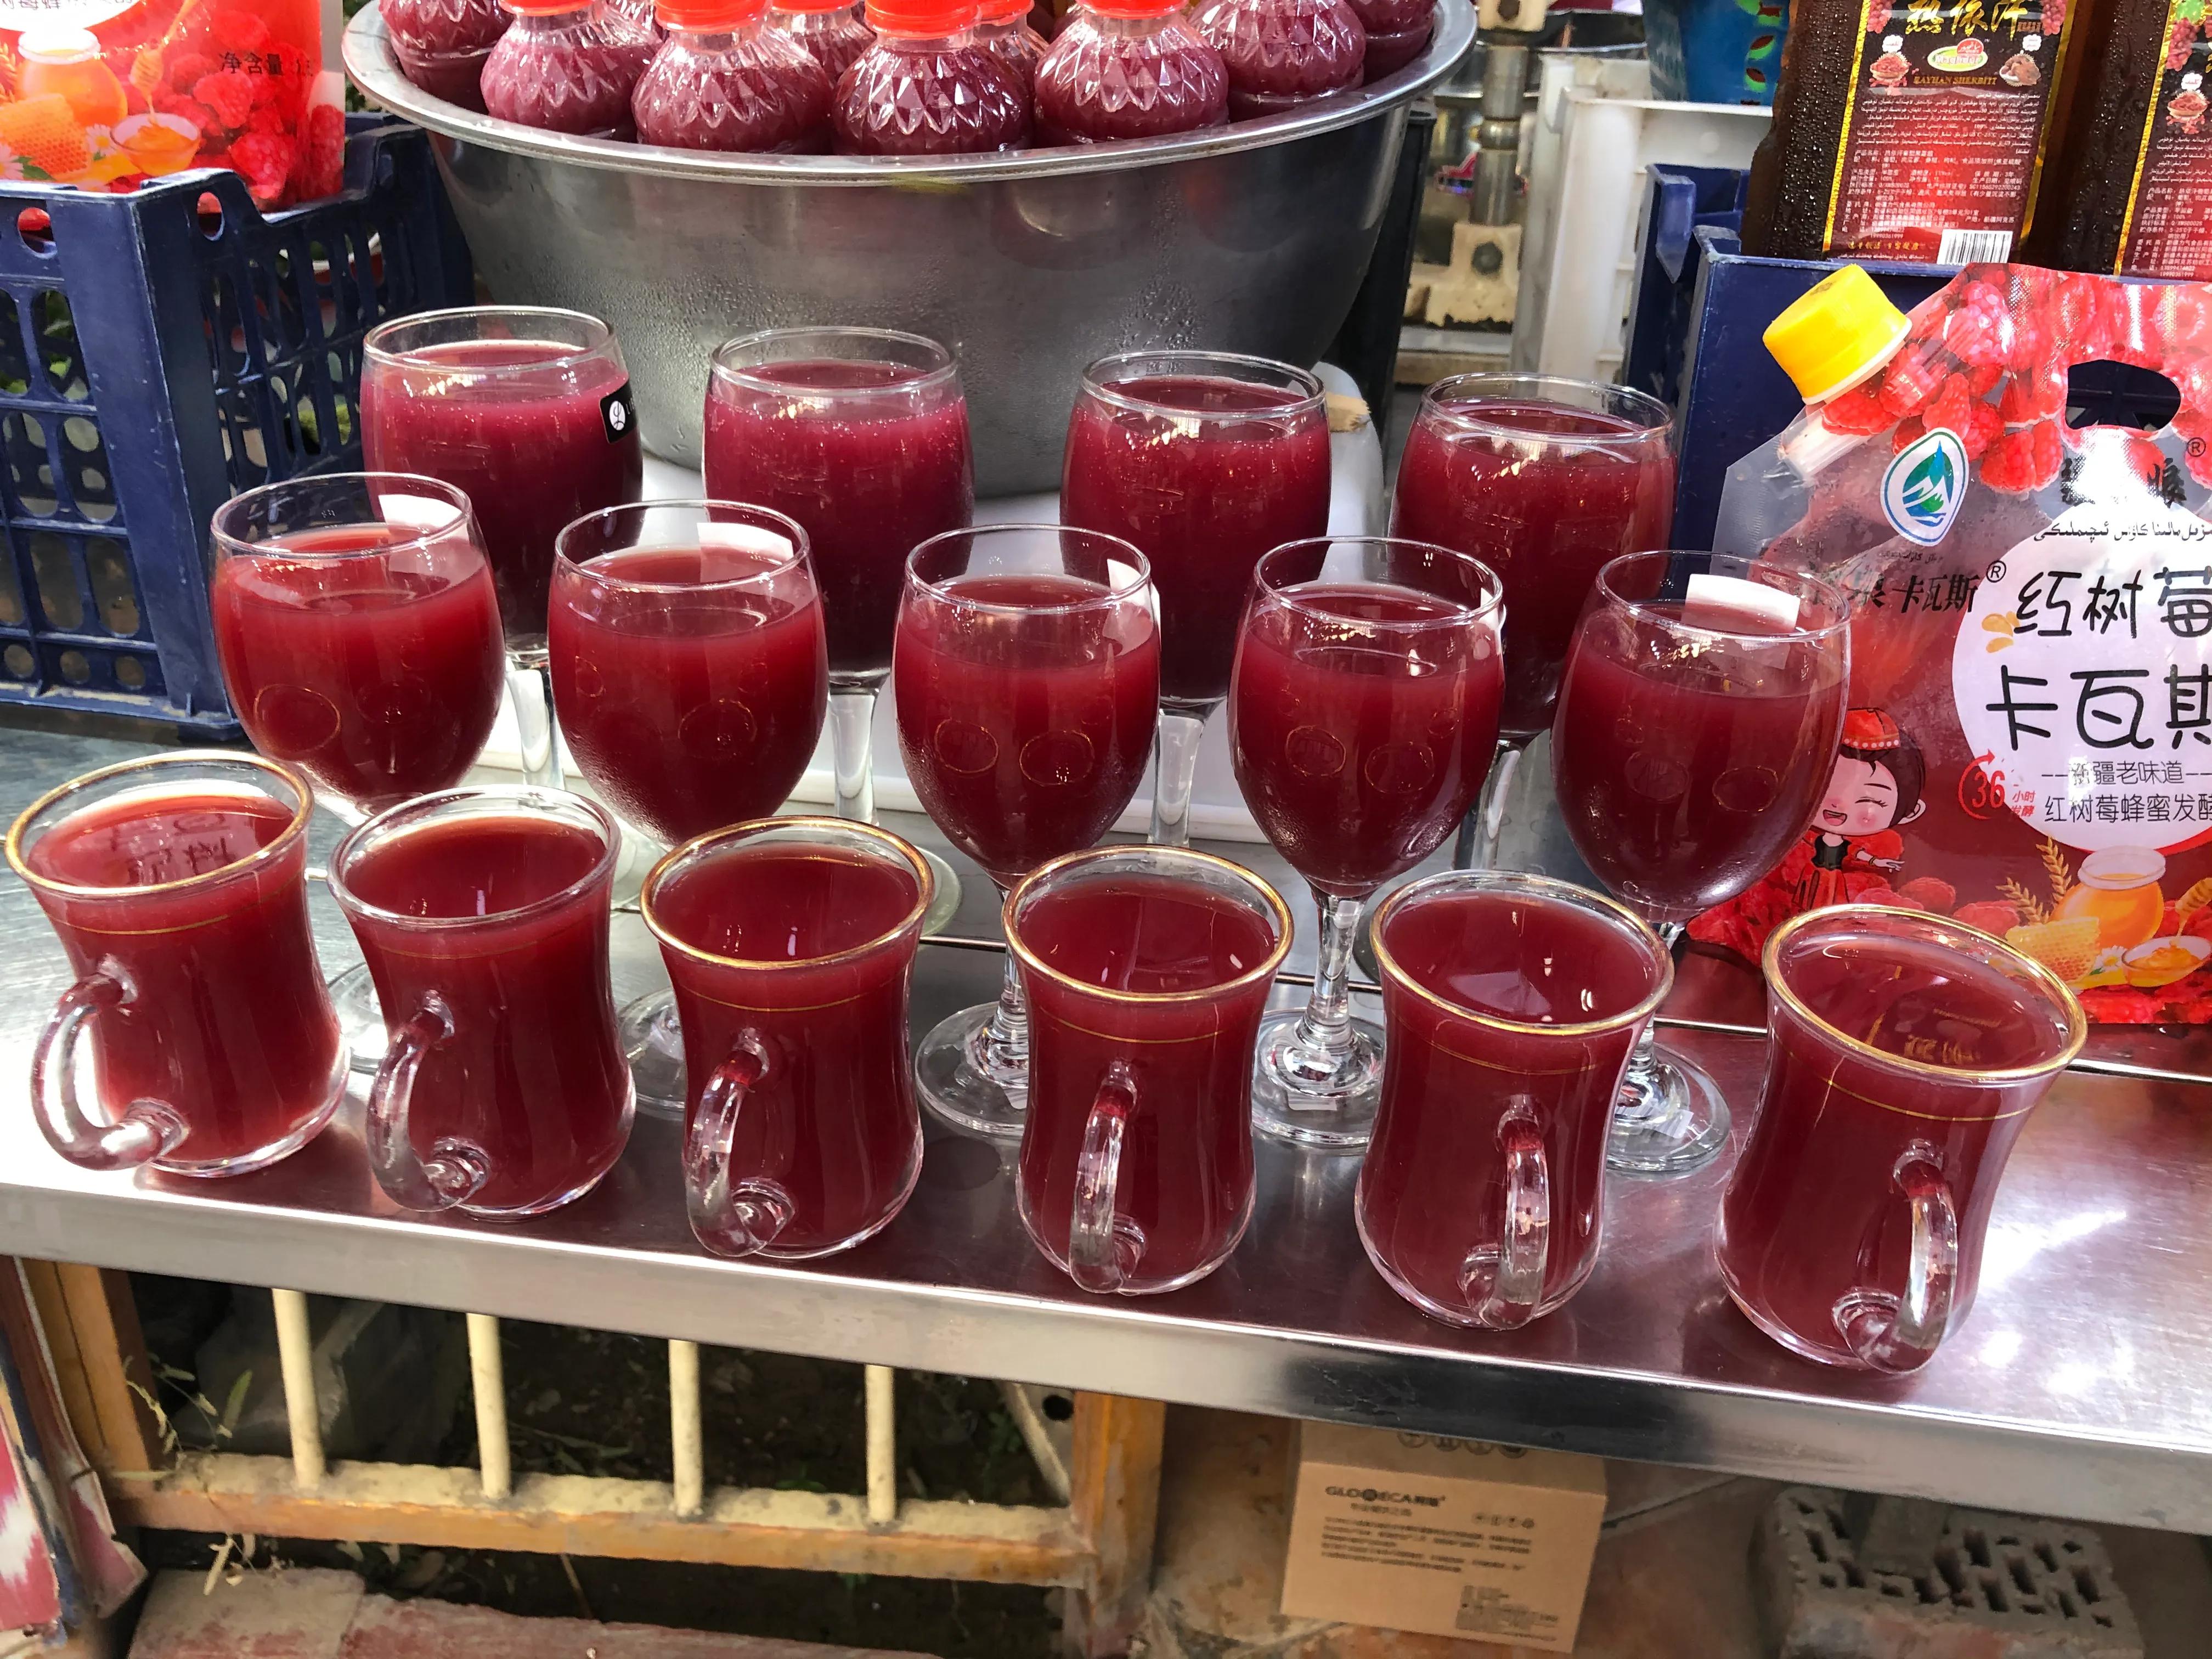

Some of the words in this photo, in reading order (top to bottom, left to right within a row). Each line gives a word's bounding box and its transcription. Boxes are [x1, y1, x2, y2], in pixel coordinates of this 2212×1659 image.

[2013, 566, 2212, 639] 红树莓
[1971, 770, 2006, 809] 36
[2012, 790, 2036, 803] 小时
